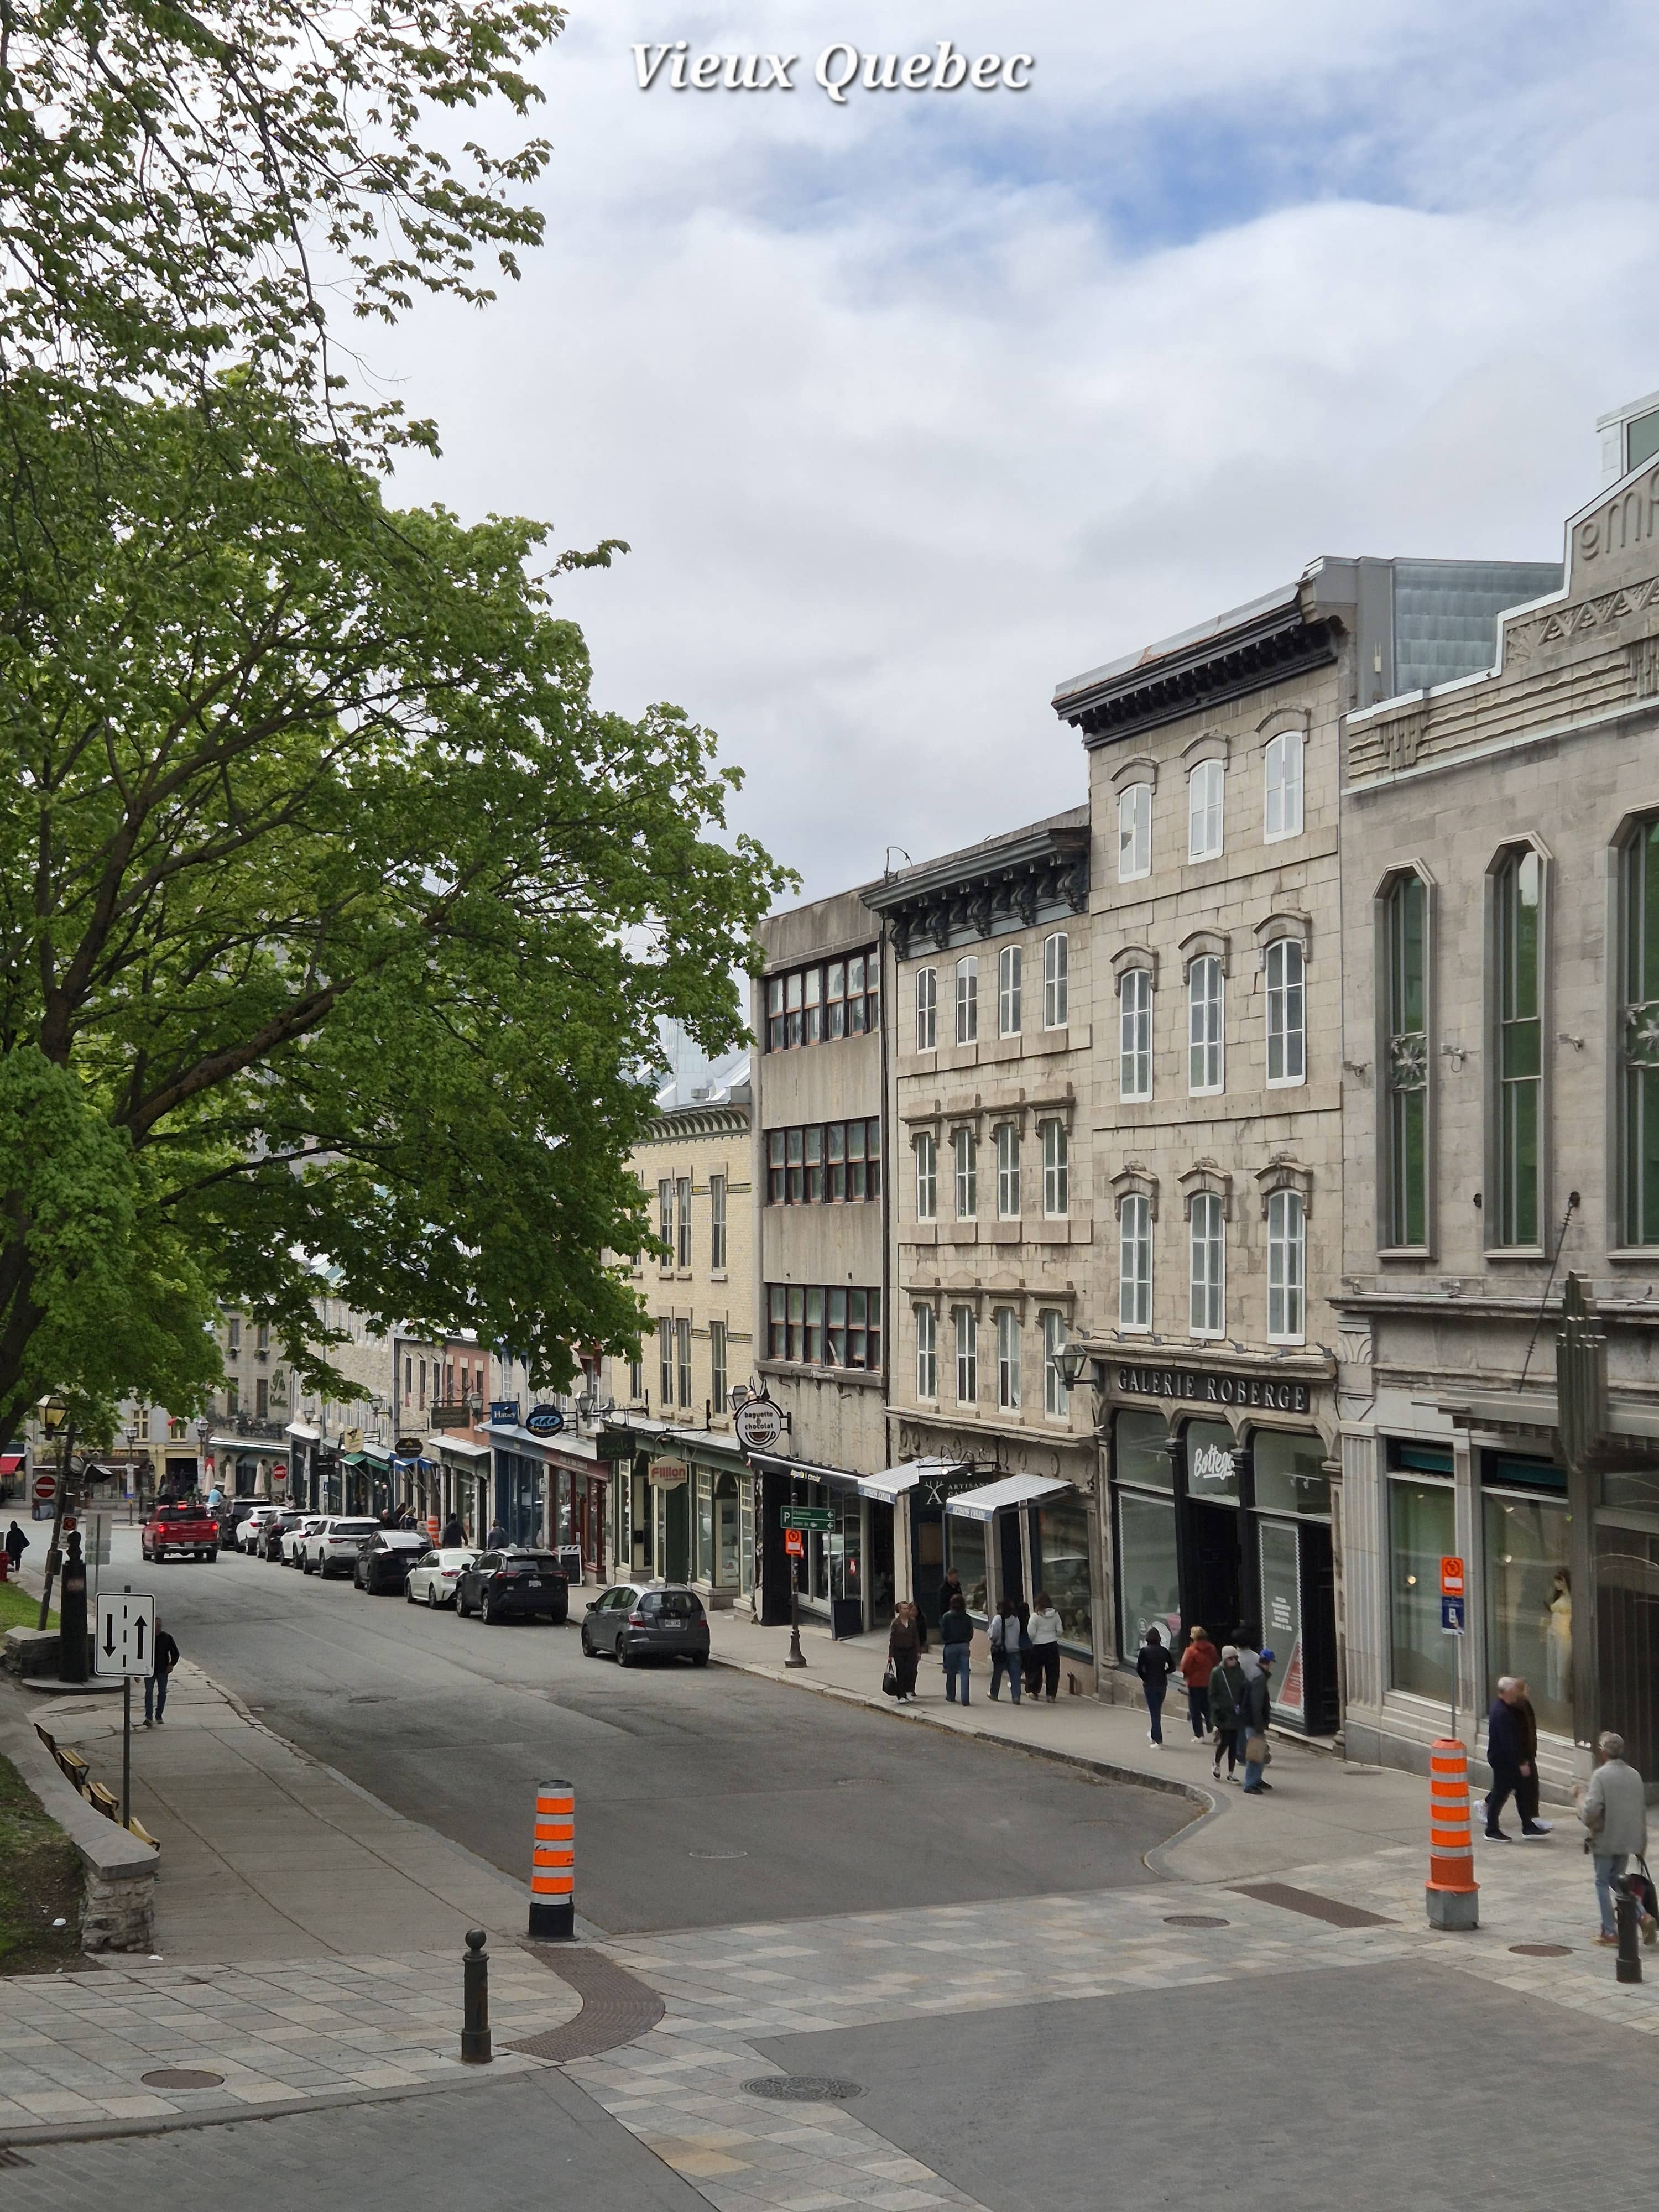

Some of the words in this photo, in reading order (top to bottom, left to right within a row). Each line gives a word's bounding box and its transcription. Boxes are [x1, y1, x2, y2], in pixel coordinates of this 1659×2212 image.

[1118, 1369, 1195, 1397] GALERIE
[1207, 1377, 1305, 1410] ROBERGE
[494, 1411, 517, 1419] Hatey
[651, 1466, 686, 1478] Fillion
[784, 1512, 791, 1522] P
